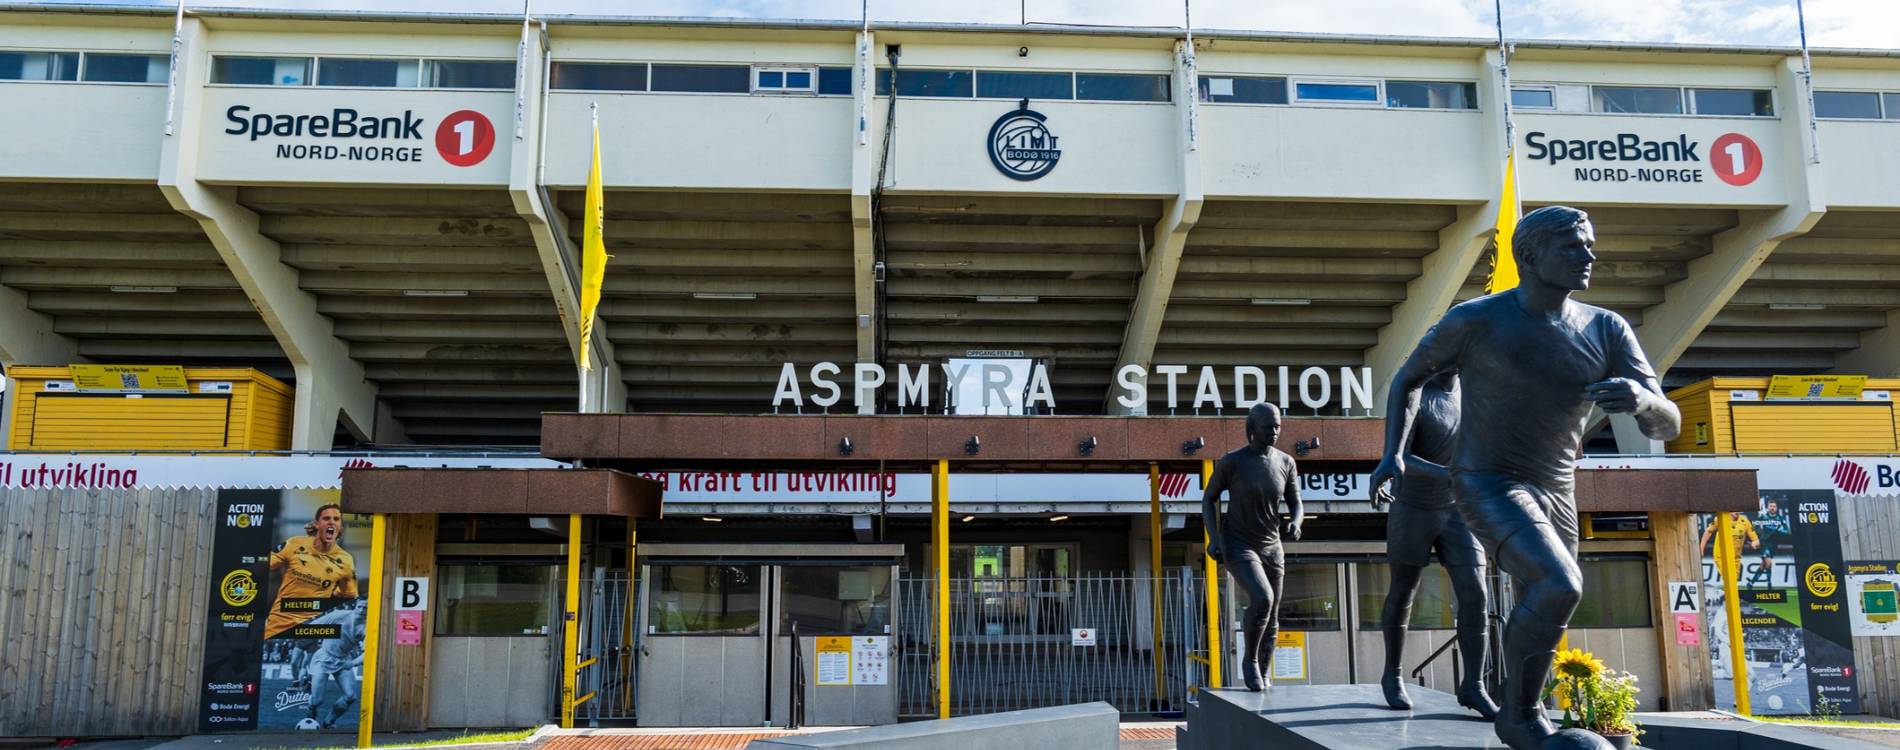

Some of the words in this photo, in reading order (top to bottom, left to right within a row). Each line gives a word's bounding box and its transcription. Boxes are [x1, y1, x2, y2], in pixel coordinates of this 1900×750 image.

[225, 105, 423, 141] SpareBank
[454, 120, 475, 156] 1
[276, 144, 423, 162] NORD-NORGE
[1007, 150, 1038, 159] BODØ
[1040, 151, 1060, 160] 1916
[1525, 131, 1700, 166] SpareBank
[1724, 142, 1746, 177] 1
[1575, 167, 1703, 183] NORD-NORGE
[772, 361, 1056, 408] ASPMYRA
[1117, 364, 1374, 410] STADION
[679, 472, 742, 492] kraft
[752, 472, 777, 492] til
[787, 472, 897, 497] utvikling
[228, 503, 264, 514] ACTION
[1799, 503, 1828, 511] ACTION
[402, 580, 420, 608] B
[1674, 585, 1697, 611] A
[1756, 592, 1781, 600] HELTER
[284, 602, 314, 611] HELTER
[295, 628, 335, 636] LEGENDER
